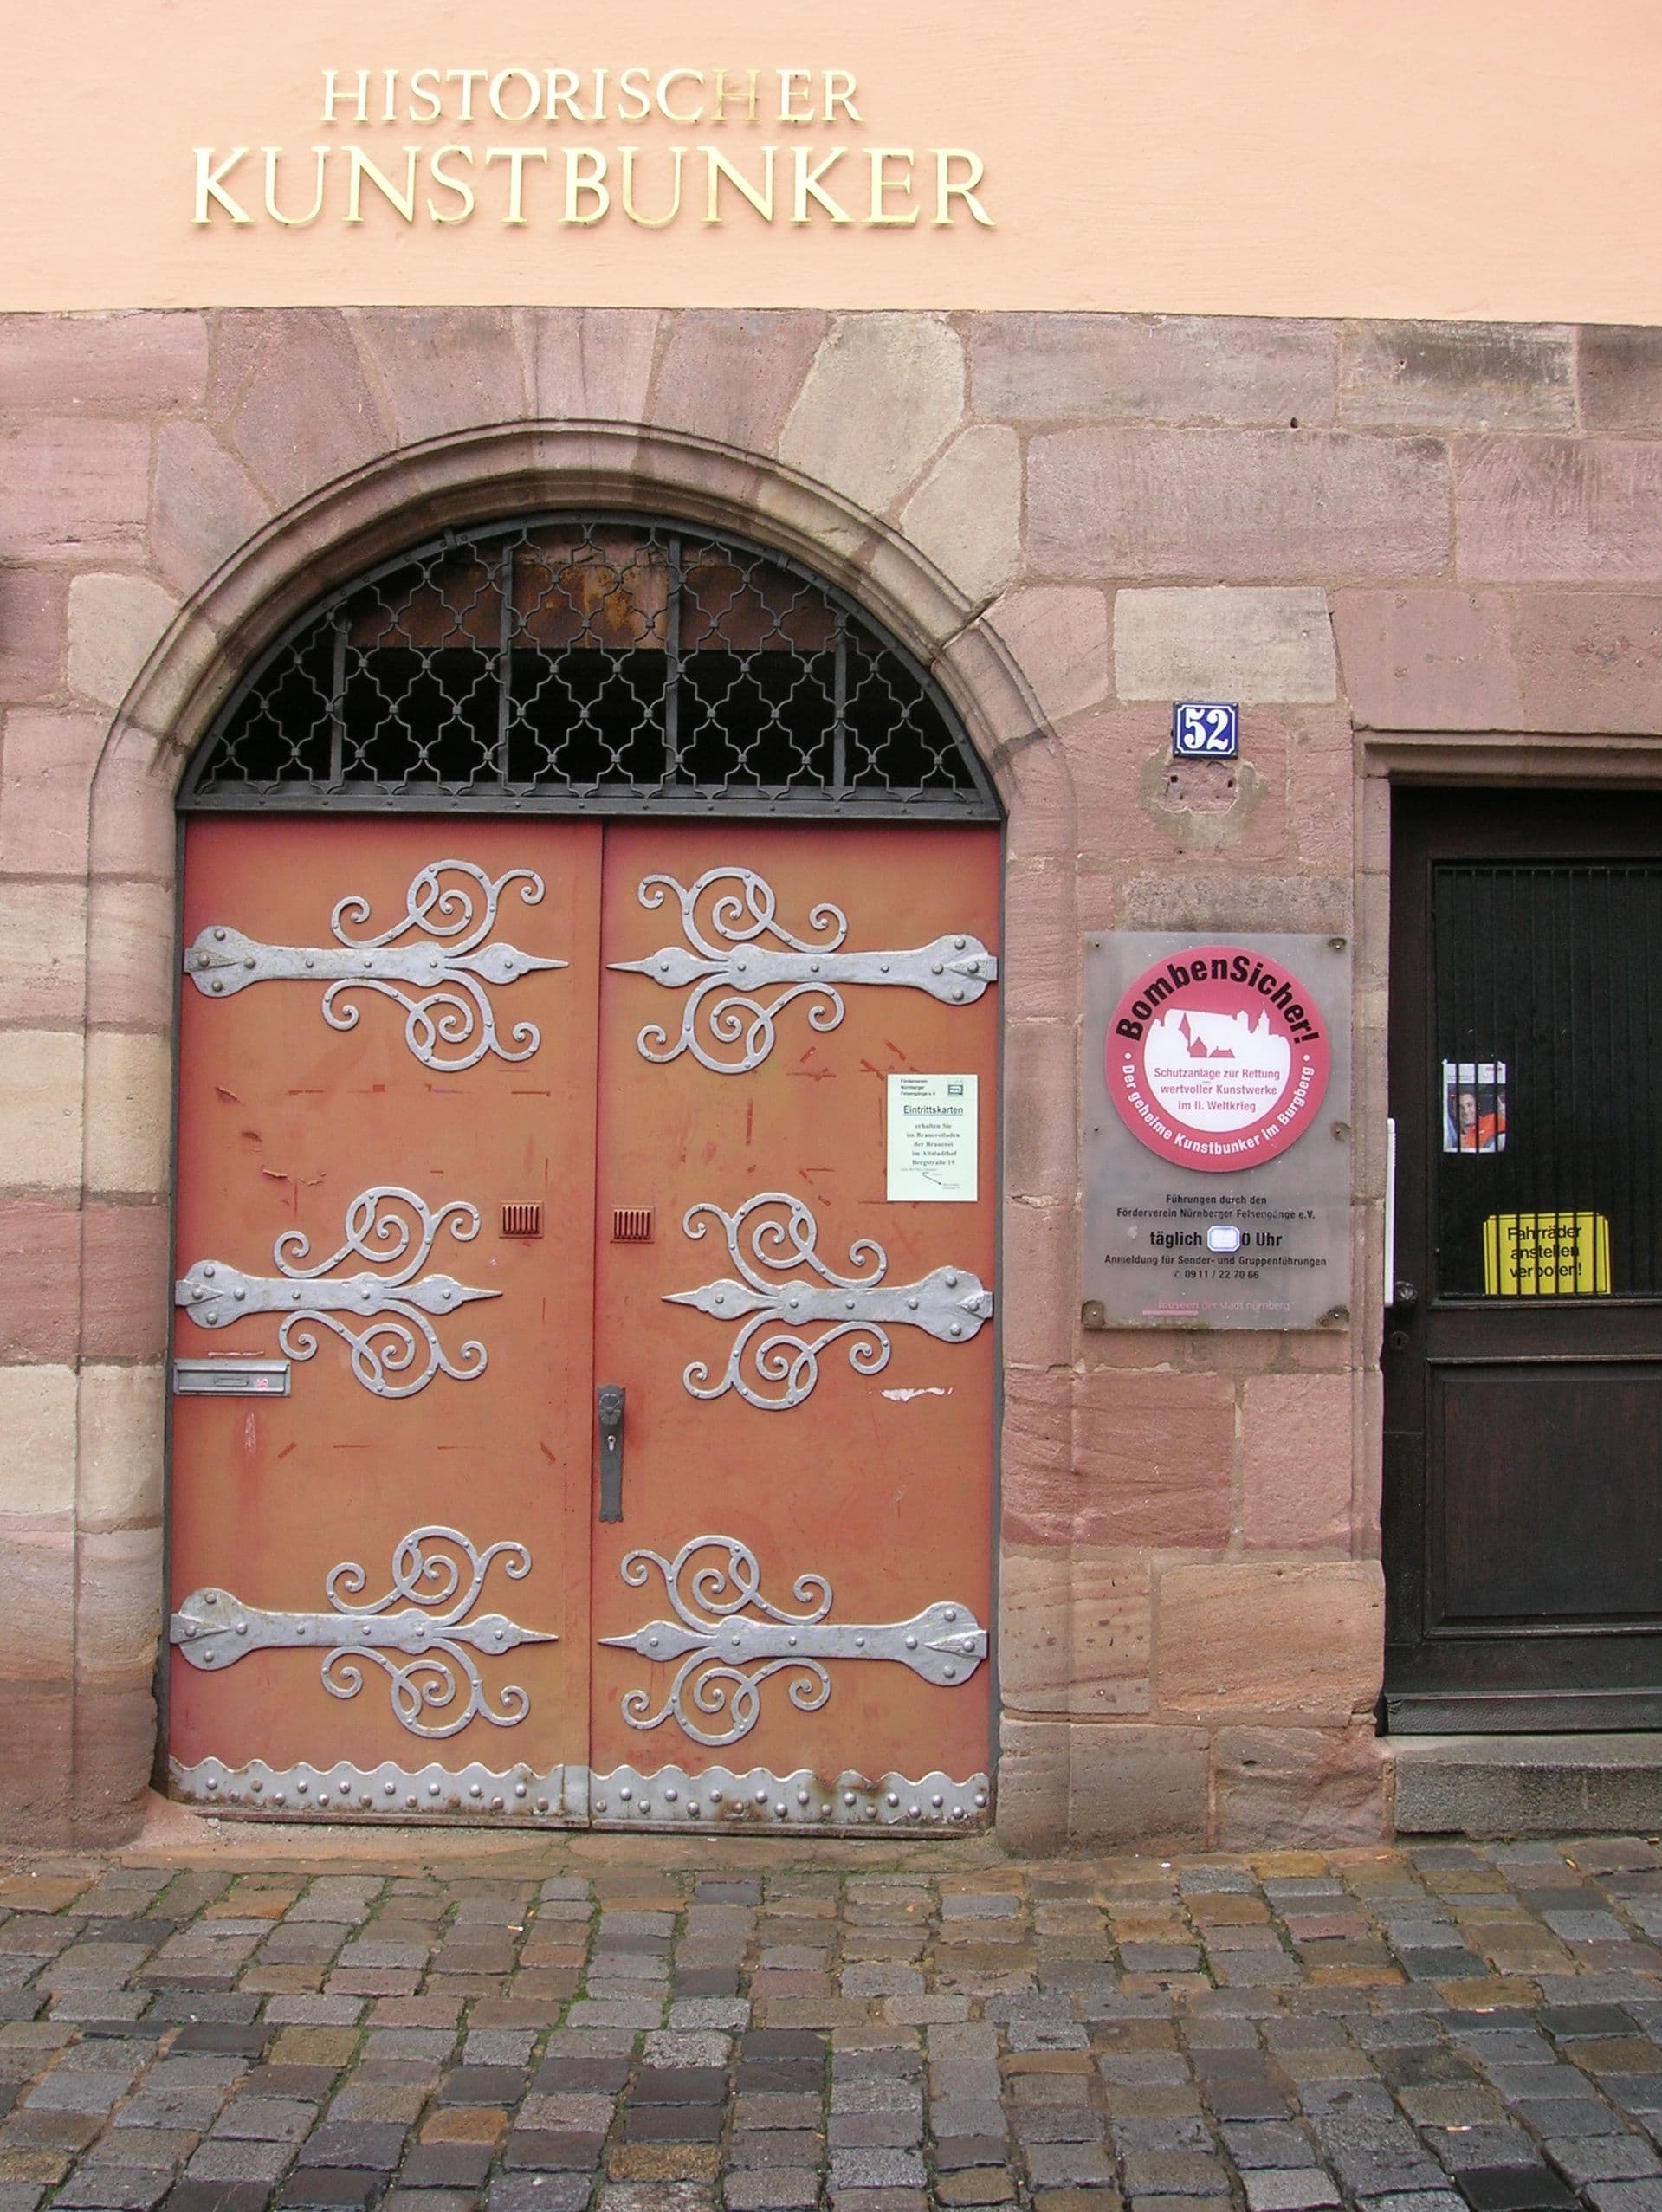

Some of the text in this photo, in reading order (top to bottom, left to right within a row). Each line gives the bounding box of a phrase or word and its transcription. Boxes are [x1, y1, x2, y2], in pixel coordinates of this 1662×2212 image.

[321, 68, 865, 123] HISTORISCHER
[190, 143, 997, 228] KUNSTBUNKER
[1183, 708, 1229, 751] 52
[1115, 955, 1320, 1045] BombenSicher!
[1154, 1067, 1280, 1081] Schutzanlage zur Rettung
[1160, 1084, 1277, 1095] wertvoller Kunstwerke
[903, 1104, 964, 1116] Eintrittskarten
[1122, 1064, 1315, 1155] Der geheime Kunstbunker im Burgberg
[1178, 1101, 1191, 1110] im
[1207, 1101, 1256, 1113] Weltkrieg
[1166, 1194, 1267, 1205] Führungen durch den
[1180, 1207, 1232, 1219] Nürnberger
[1298, 1210, 1316, 1219] e.V.
[1150, 1231, 1202, 1248] täglich
[1256, 1232, 1283, 1246] Uhr
[1510, 1245, 1580, 1260] anstelen
[1104, 1255, 1327, 1268] Anmeldung für Sonder- und Gruppenführungen
[1509, 1261, 1582, 1278] verboen!
